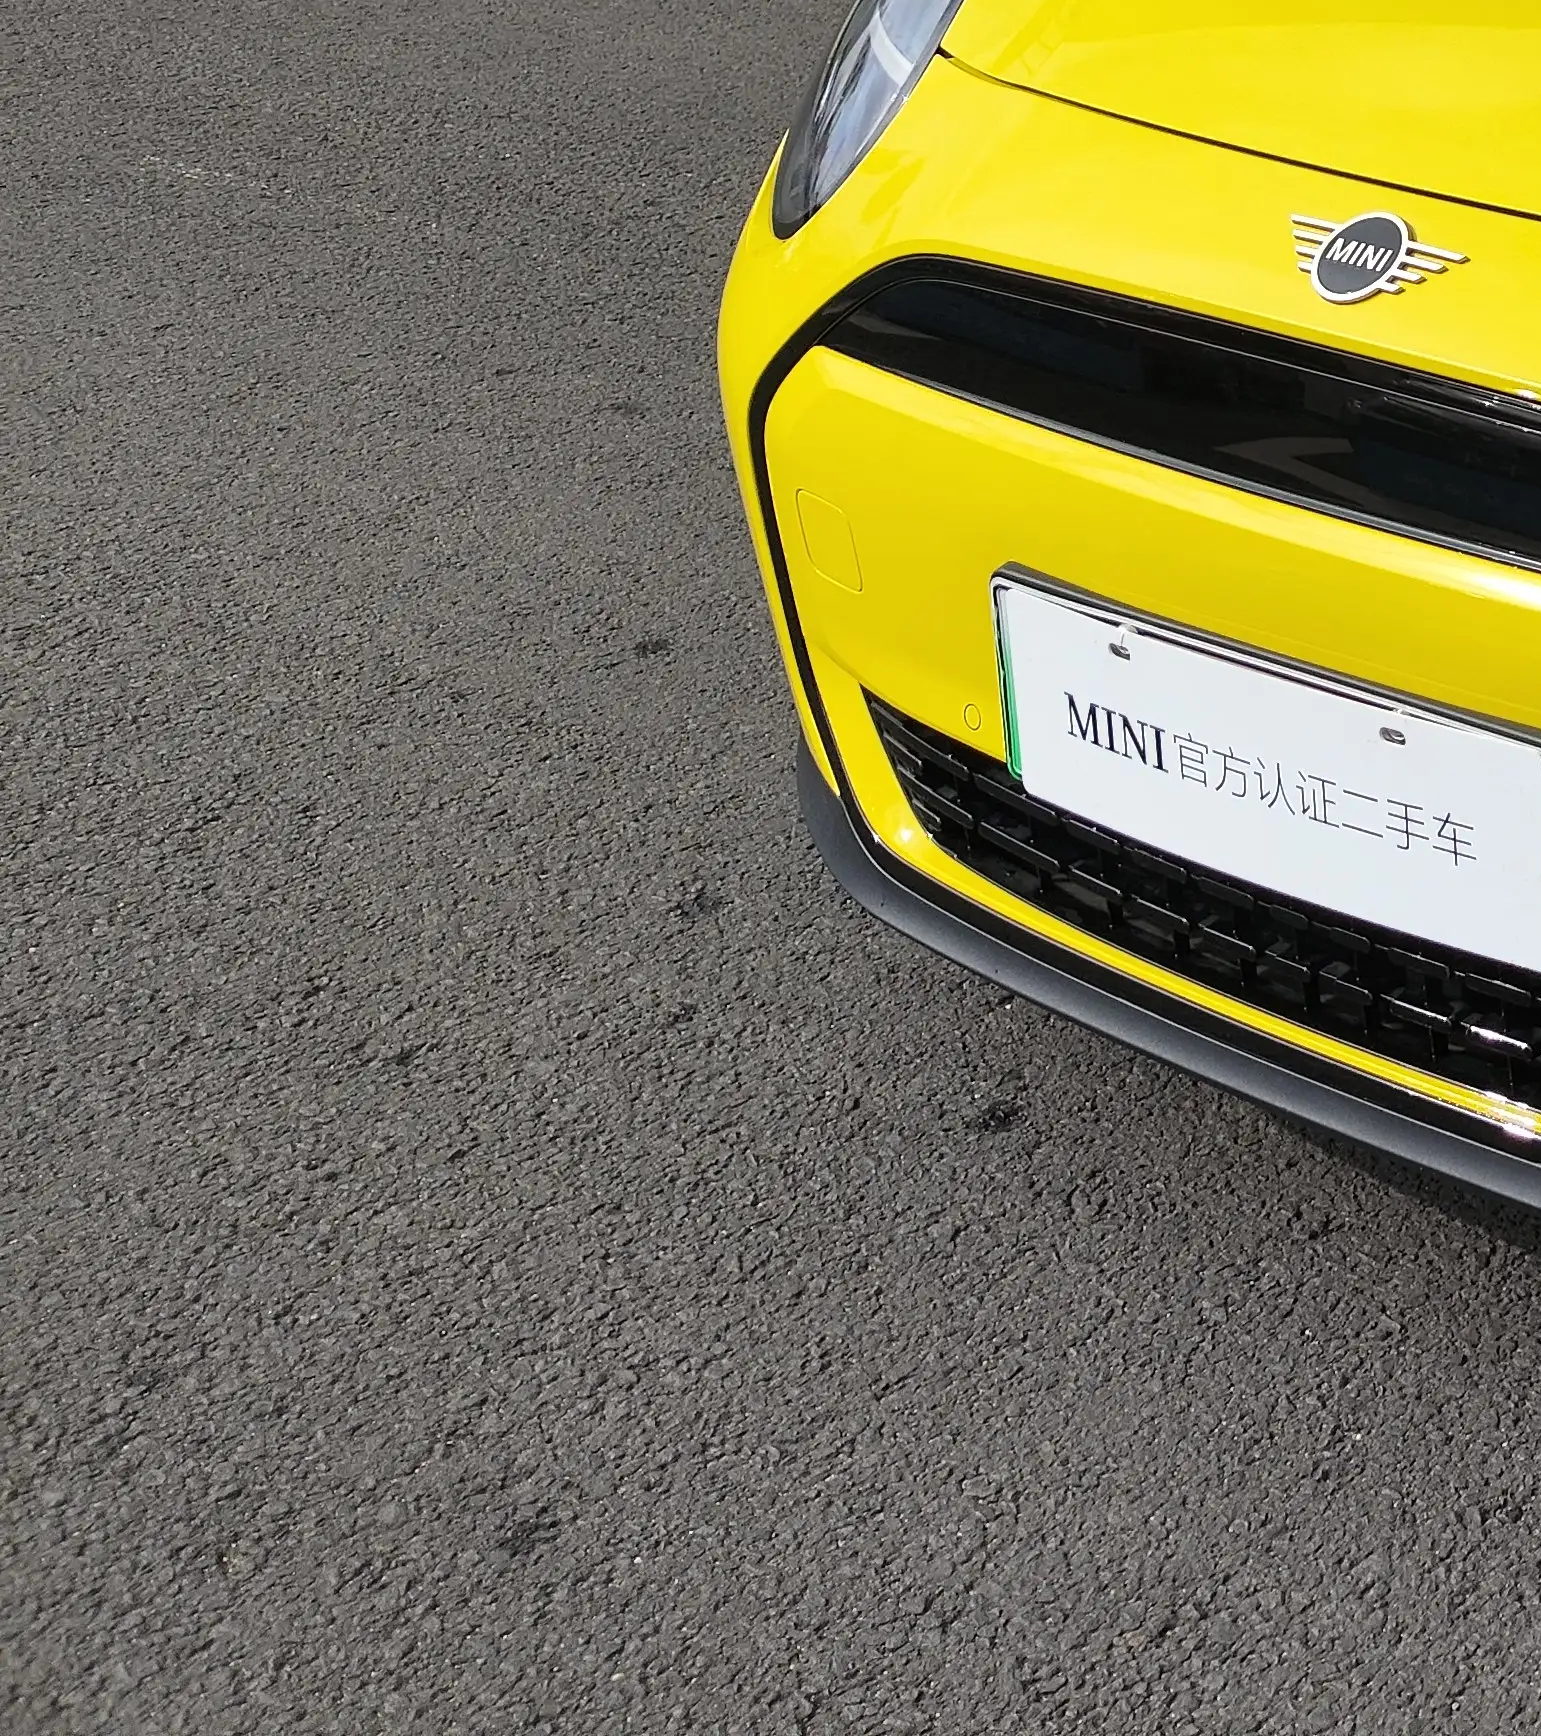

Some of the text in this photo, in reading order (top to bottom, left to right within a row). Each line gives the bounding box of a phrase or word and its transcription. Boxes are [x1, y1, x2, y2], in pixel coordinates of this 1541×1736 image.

[1325, 237, 1394, 272] MINI
[1063, 691, 1478, 867] MINI官方认证二手车
